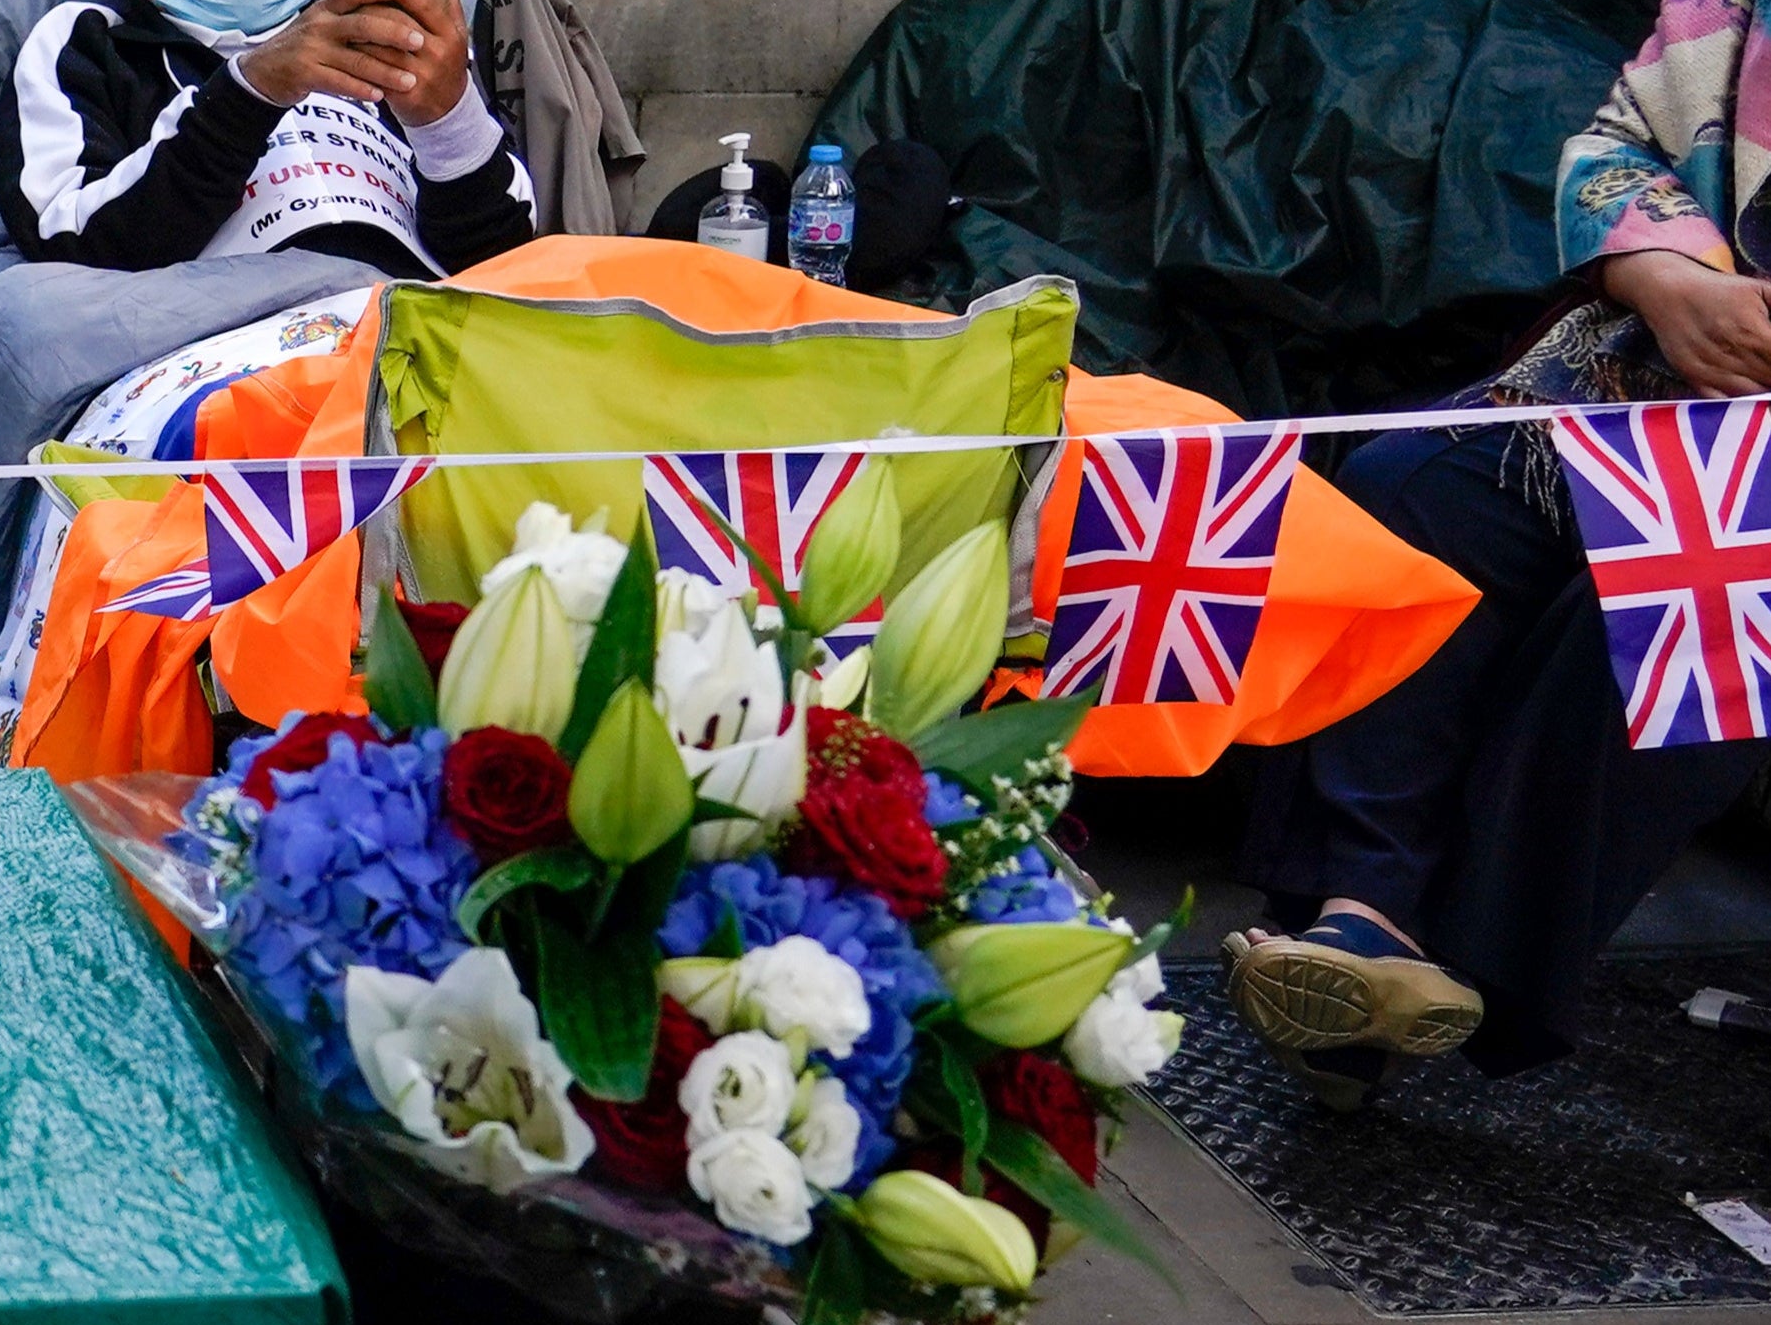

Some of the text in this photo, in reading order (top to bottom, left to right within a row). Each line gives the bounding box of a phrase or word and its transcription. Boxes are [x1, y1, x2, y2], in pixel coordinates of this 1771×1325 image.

[268, 160, 415, 220] UNTO DEAT
[249, 209, 283, 239] (Mr
